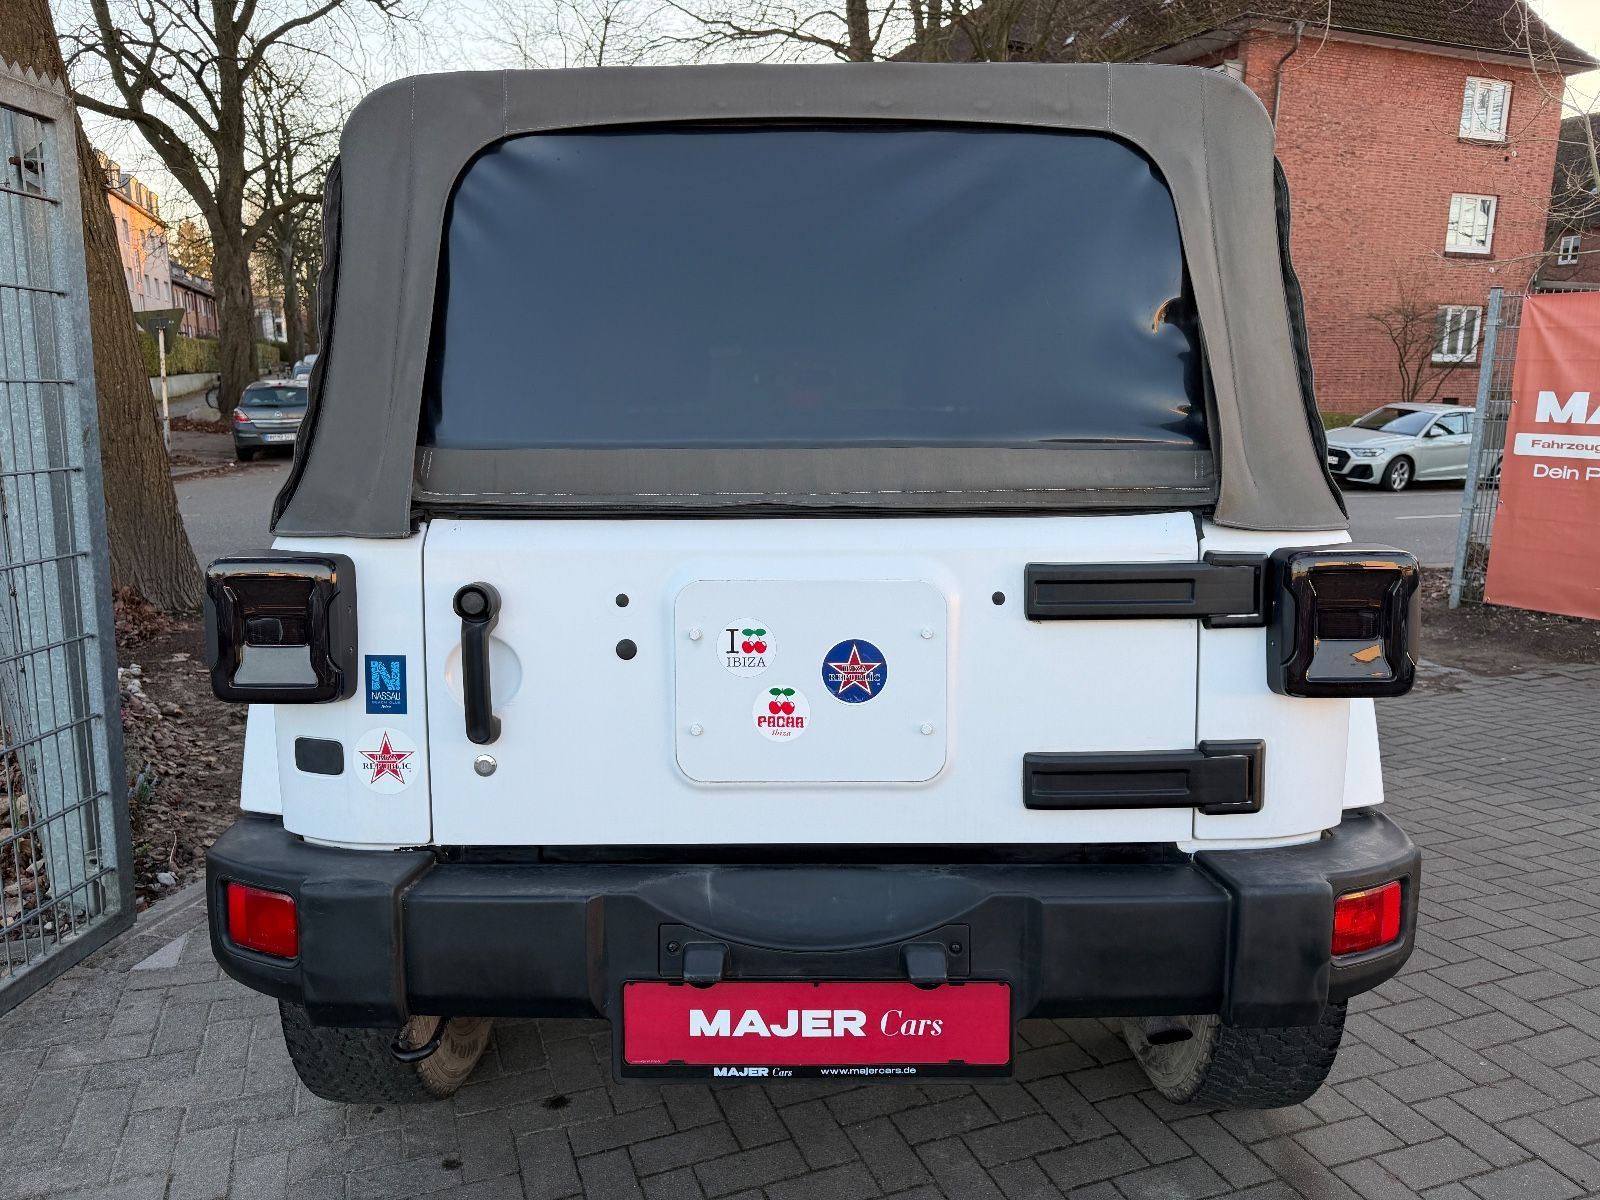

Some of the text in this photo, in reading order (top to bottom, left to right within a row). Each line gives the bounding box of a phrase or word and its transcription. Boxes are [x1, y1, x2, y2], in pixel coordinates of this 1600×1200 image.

[1533, 463, 1579, 480] Dein
[726, 628, 739, 654] I
[726, 656, 767, 668] IBIZA
[371, 691, 401, 701] NASSAU
[757, 715, 804, 729] PACHA
[689, 1009, 943, 1037] MAJER Cars
[713, 1067, 793, 1077] MAJER Cars
[820, 1066, 917, 1076] www.majercars.de
